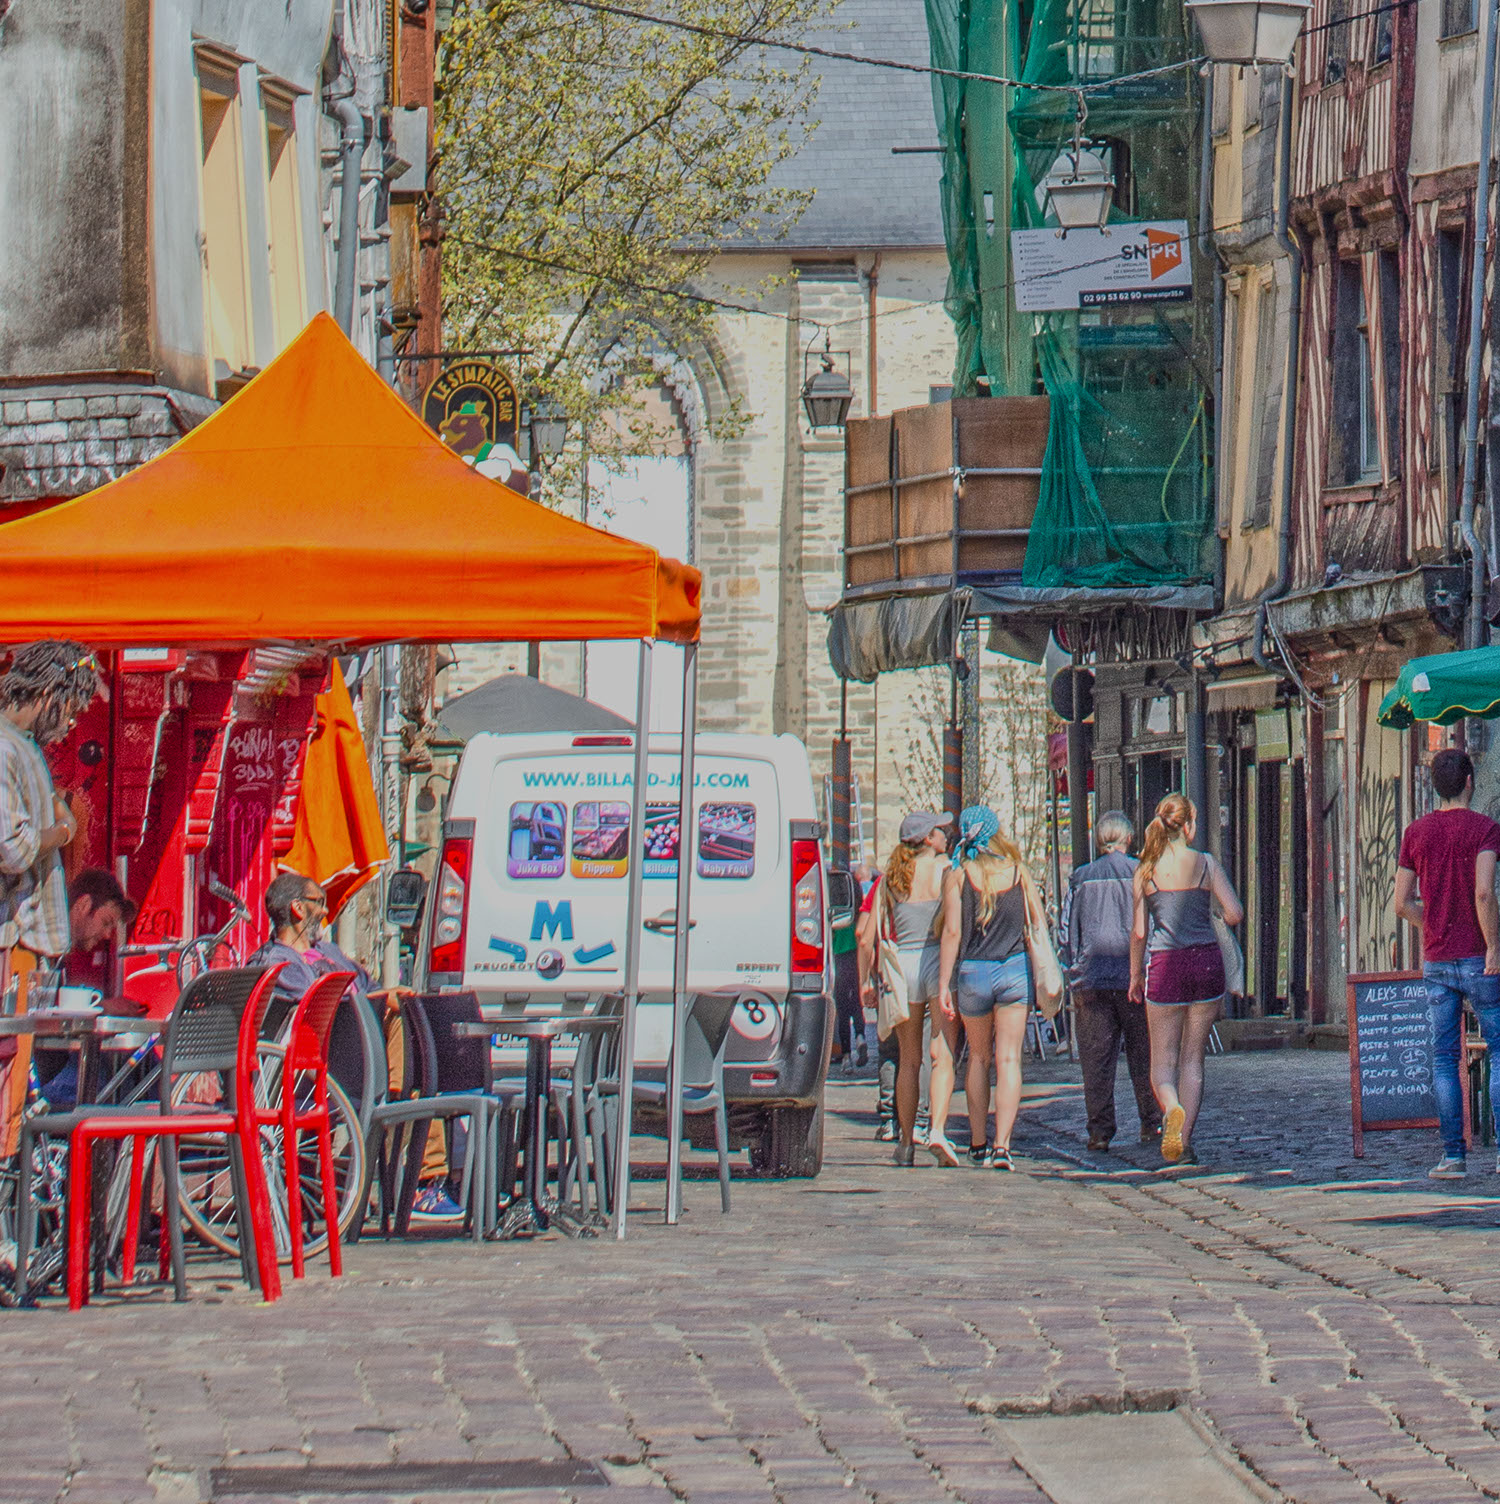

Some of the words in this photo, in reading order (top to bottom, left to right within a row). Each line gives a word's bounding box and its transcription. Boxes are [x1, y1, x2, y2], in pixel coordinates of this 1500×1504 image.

[1121, 243, 1178, 260] SNPR
[1096, 294, 1106, 302] 99
[432, 380, 451, 402] LE
[447, 365, 512, 401] SYMPATIC
[499, 400, 513, 422] BAR
[523, 771, 750, 788] WWW.BILLAD-JJ.COM
[516, 863, 540, 875] Juke
[541, 863, 559, 875] Box
[582, 863, 616, 876] Flipper
[703, 863, 728, 876] Baby
[473, 963, 535, 972] PEUGEOT
[736, 963, 781, 972] EXPERT
[1365, 985, 1397, 1003] ALEX'S
[742, 997, 767, 1024] 8
[1358, 1013, 1389, 1023] GALETTE
[1358, 1026, 1389, 1036] GALETTE
[1359, 1041, 1389, 1051] FRITES
[1393, 1037, 1428, 1048] MAISON
[1362, 1069, 1399, 1079] PINTE
